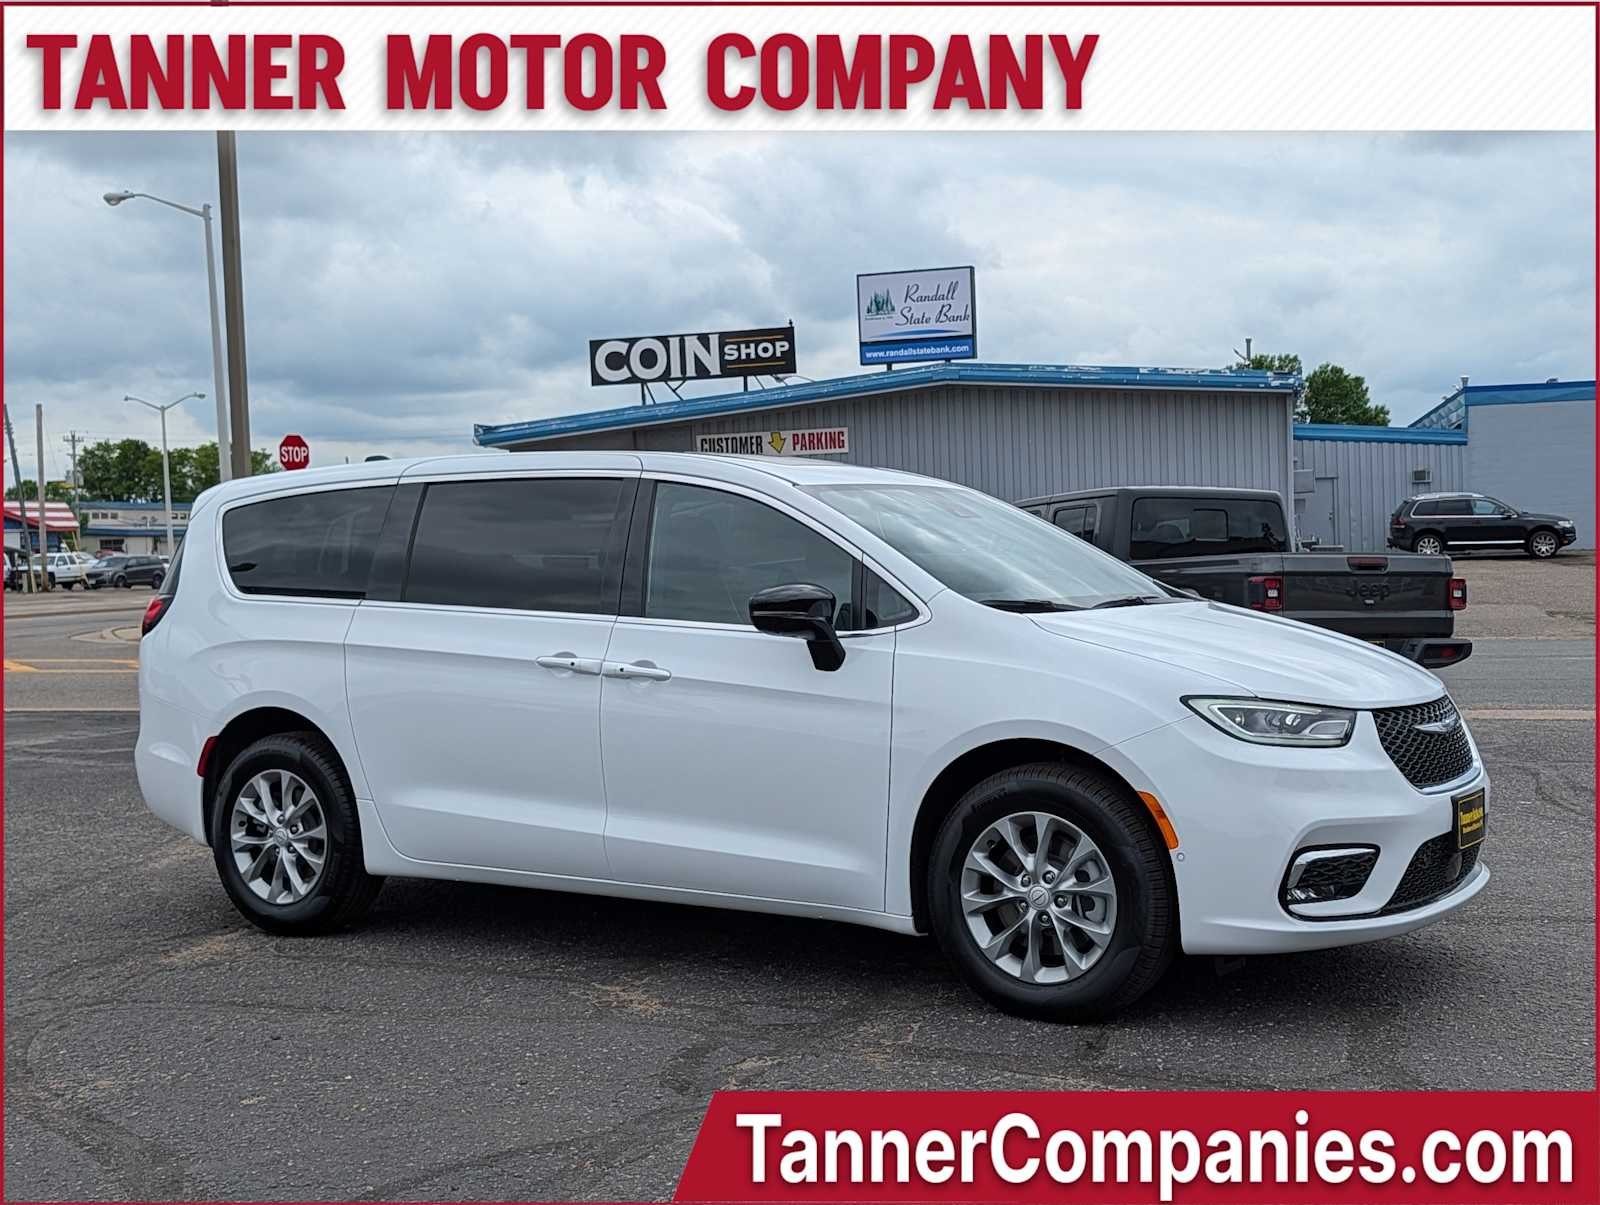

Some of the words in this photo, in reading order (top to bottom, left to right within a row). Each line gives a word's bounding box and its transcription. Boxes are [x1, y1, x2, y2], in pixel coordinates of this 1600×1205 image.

[904, 280, 959, 304] Randall
[895, 306, 931, 326] State
[935, 303, 970, 323] Bank
[595, 334, 721, 382] COIN
[724, 341, 790, 361] SHOP
[865, 344, 969, 358] www.randallstatebank.com
[281, 446, 308, 462] STOP
[701, 435, 763, 454] CUSTOMER
[792, 431, 845, 451] PARKING
[1345, 581, 1390, 600] Jeep
